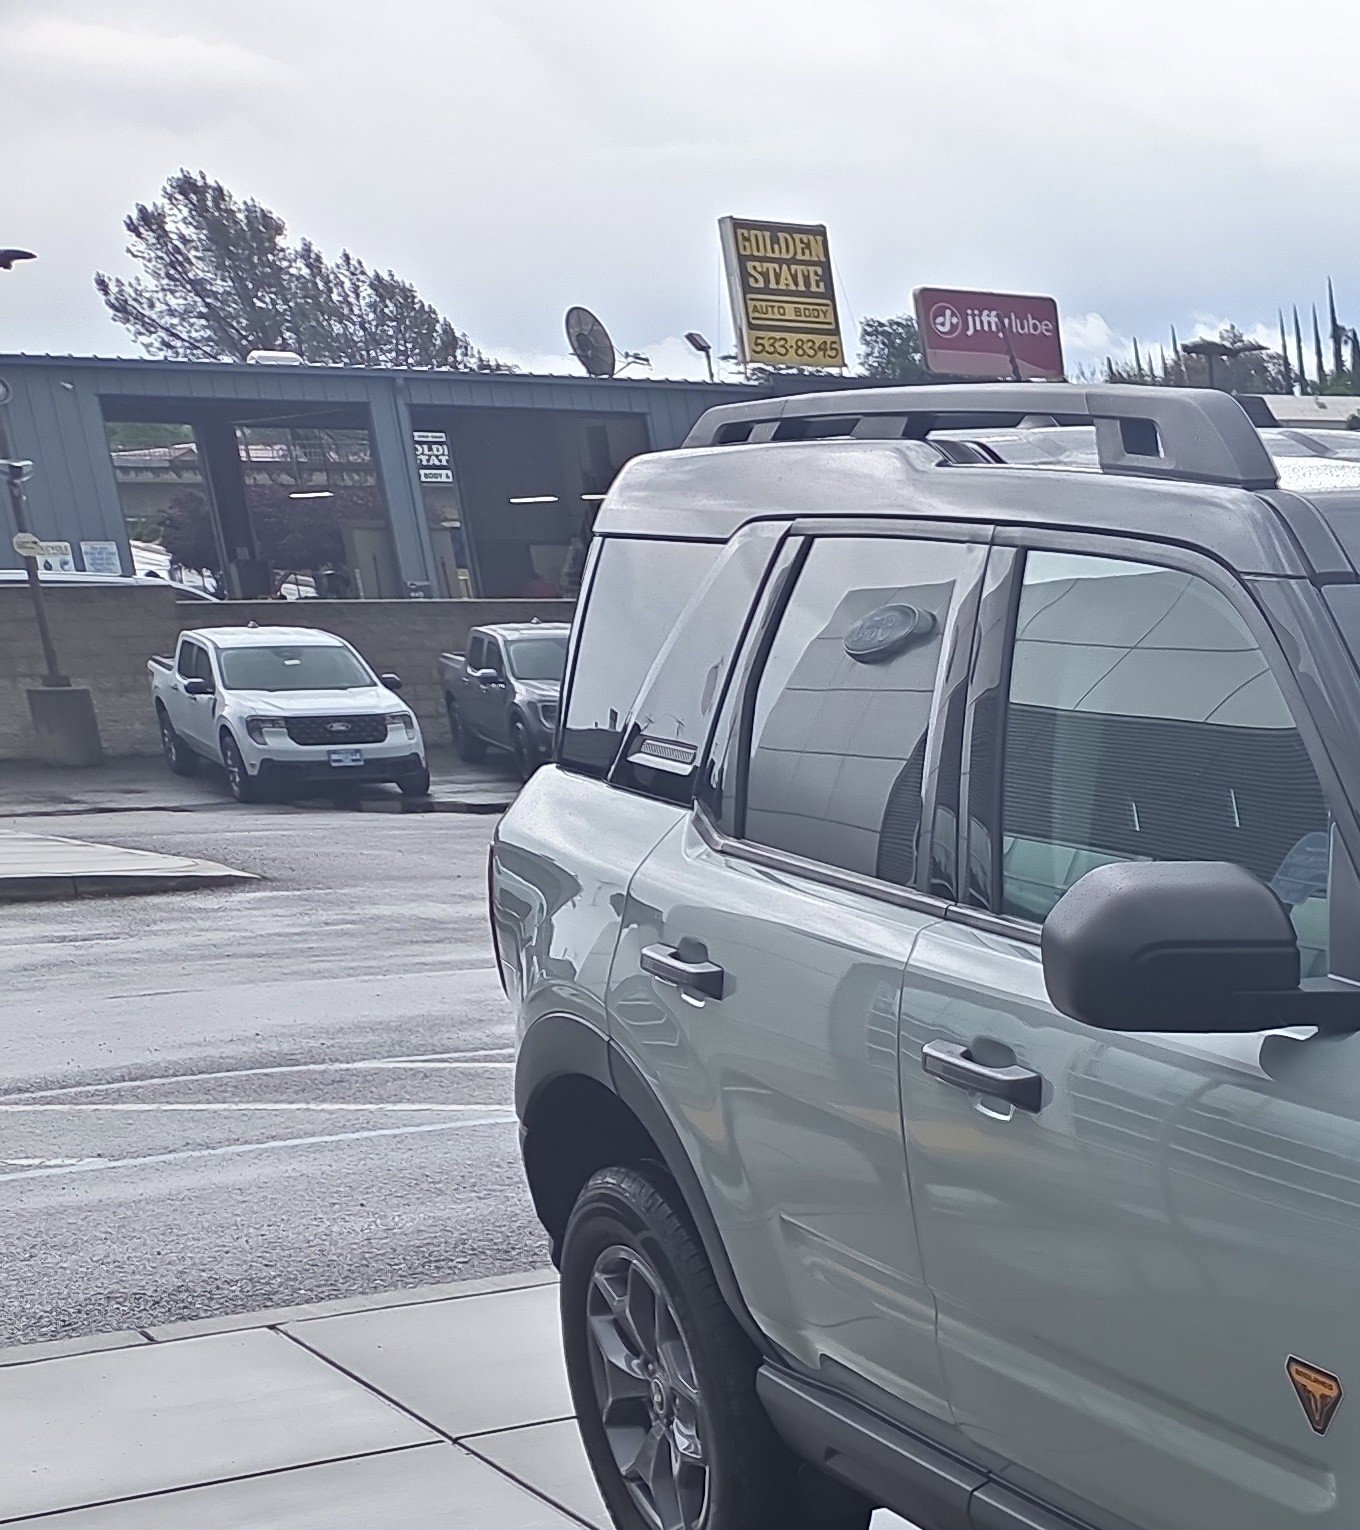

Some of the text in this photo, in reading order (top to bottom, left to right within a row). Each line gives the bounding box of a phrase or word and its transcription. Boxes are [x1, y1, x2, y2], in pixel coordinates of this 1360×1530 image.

[737, 228, 826, 262] GOLDEN
[746, 261, 825, 292] STATE
[751, 303, 829, 319] AUTO BODY
[1011, 312, 1053, 336] lube
